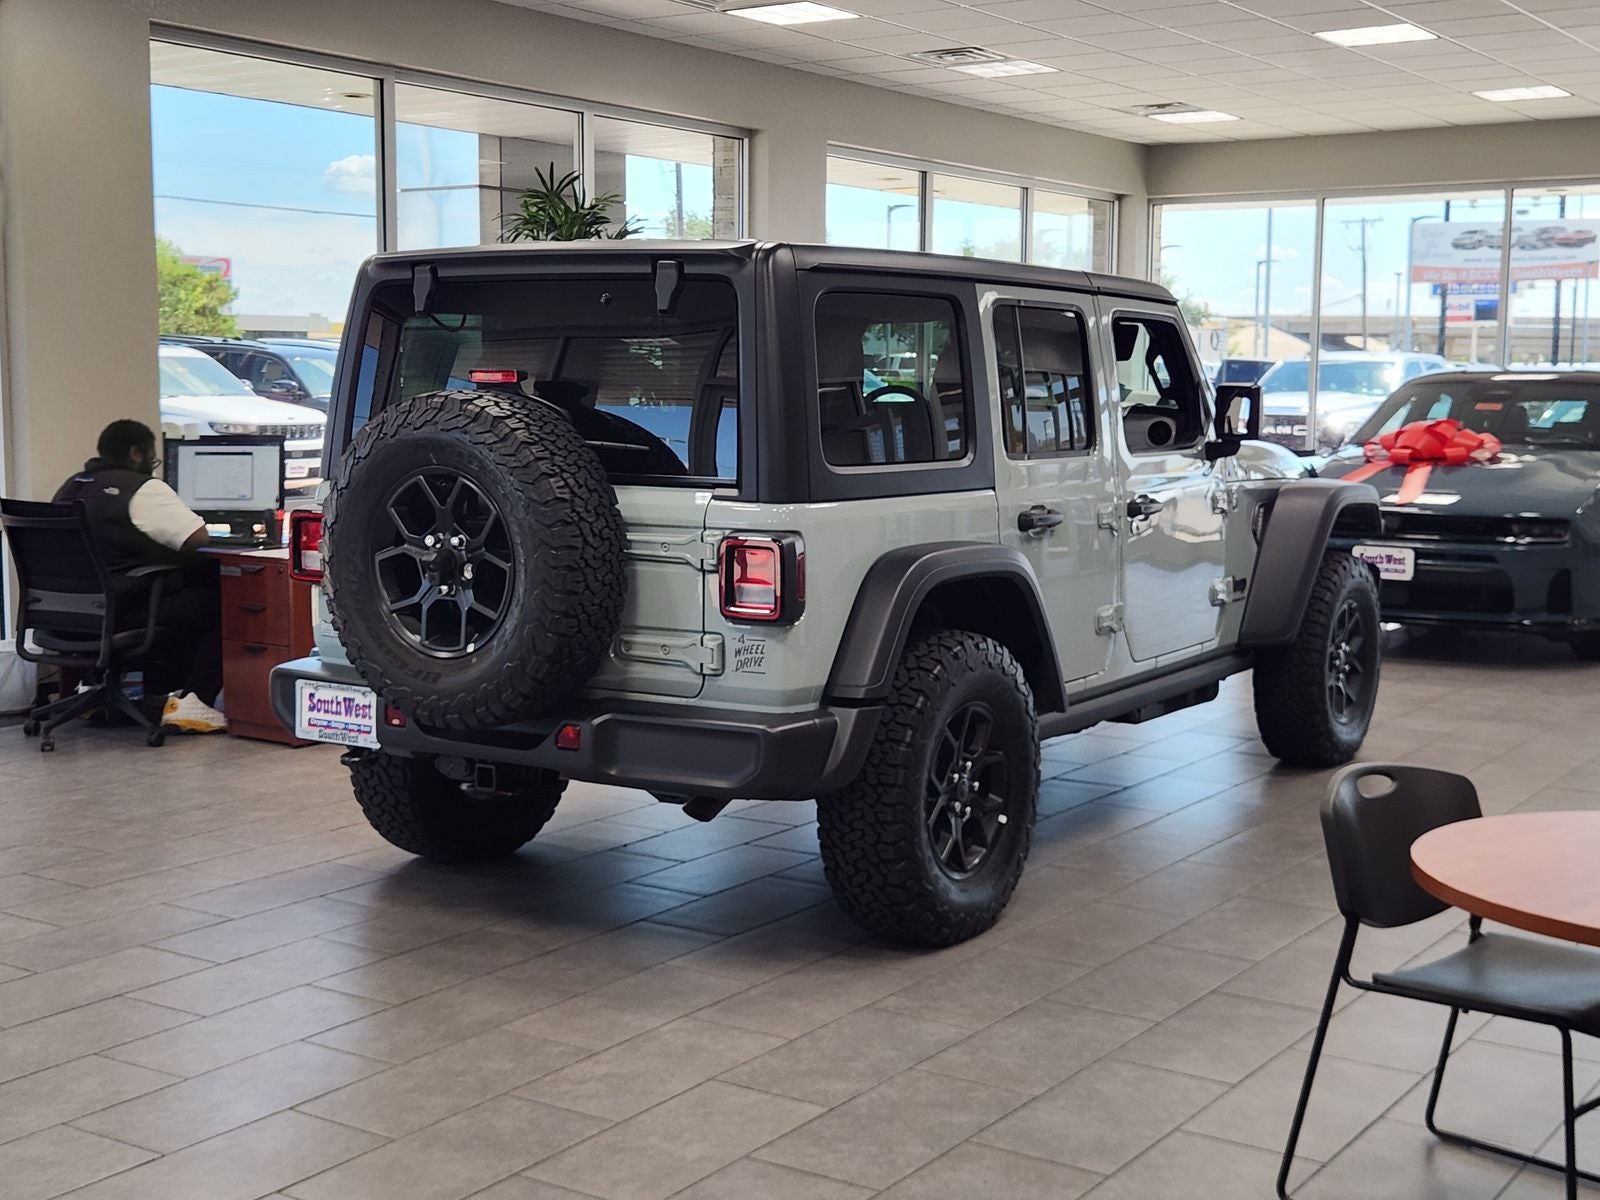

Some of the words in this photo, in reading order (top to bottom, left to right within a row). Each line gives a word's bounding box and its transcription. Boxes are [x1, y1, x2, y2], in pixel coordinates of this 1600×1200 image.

[737, 634, 746, 644] 4
[734, 643, 766, 659] WHEEL
[735, 656, 765, 672] DRIVE
[308, 692, 372, 720] SouthWest
[318, 729, 359, 744] SouthWest
